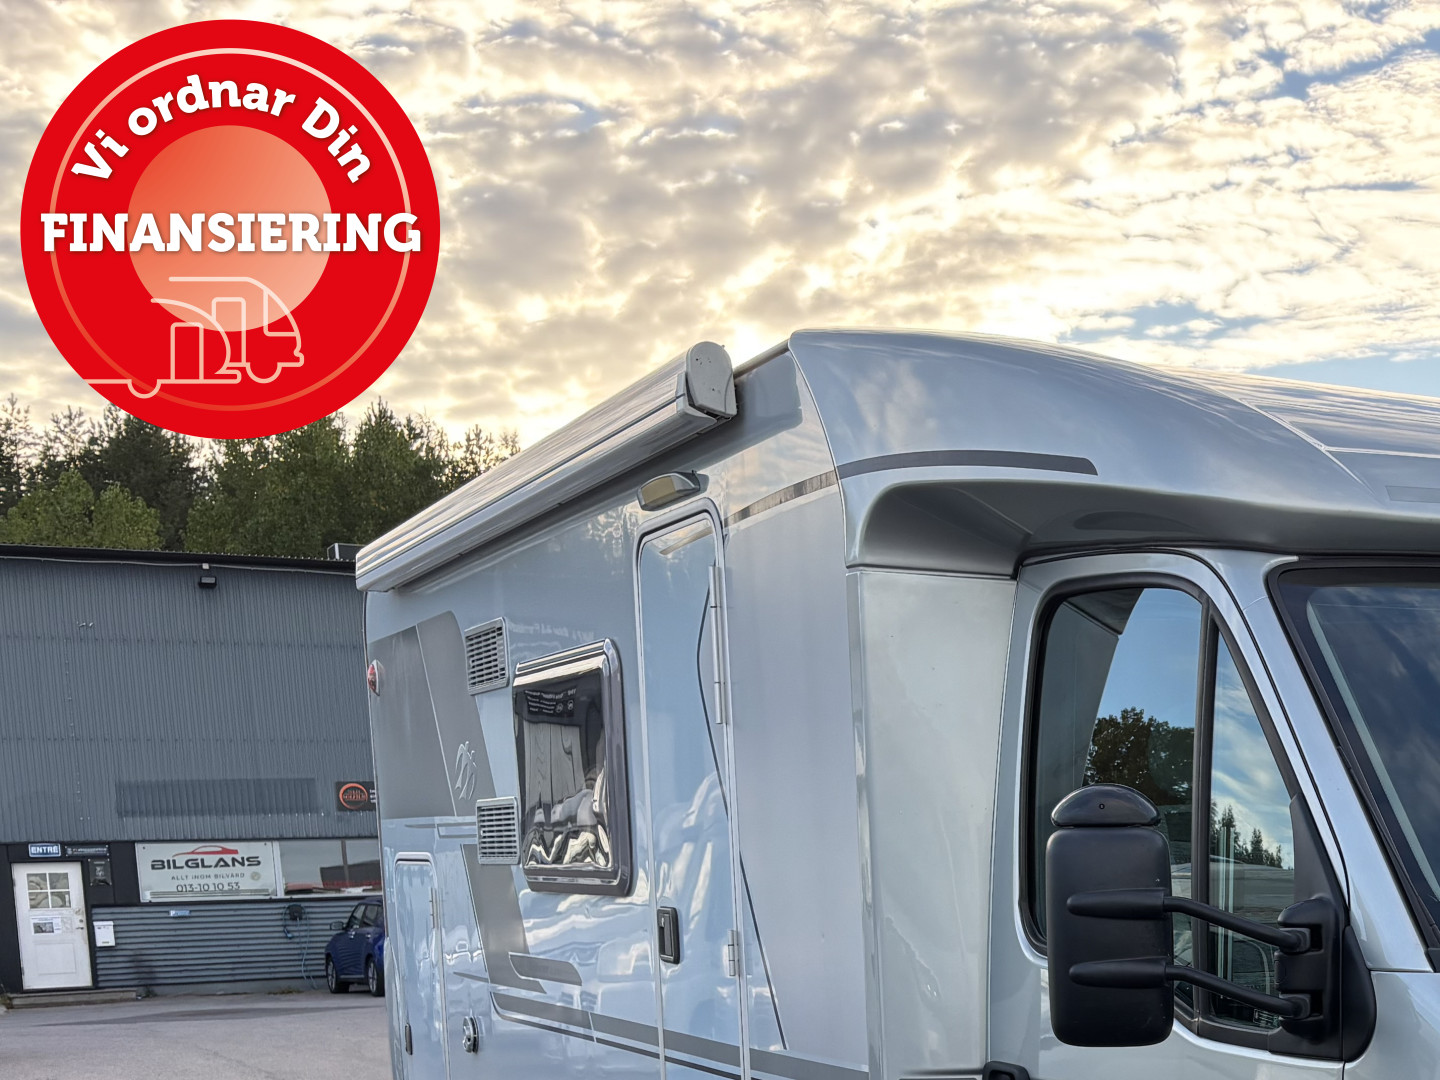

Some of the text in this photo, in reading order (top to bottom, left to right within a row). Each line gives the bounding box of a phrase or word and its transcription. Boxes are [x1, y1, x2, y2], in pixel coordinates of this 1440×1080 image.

[151, 856, 262, 870] BILGLANS
[176, 881, 241, 893] 013-10 10 53
